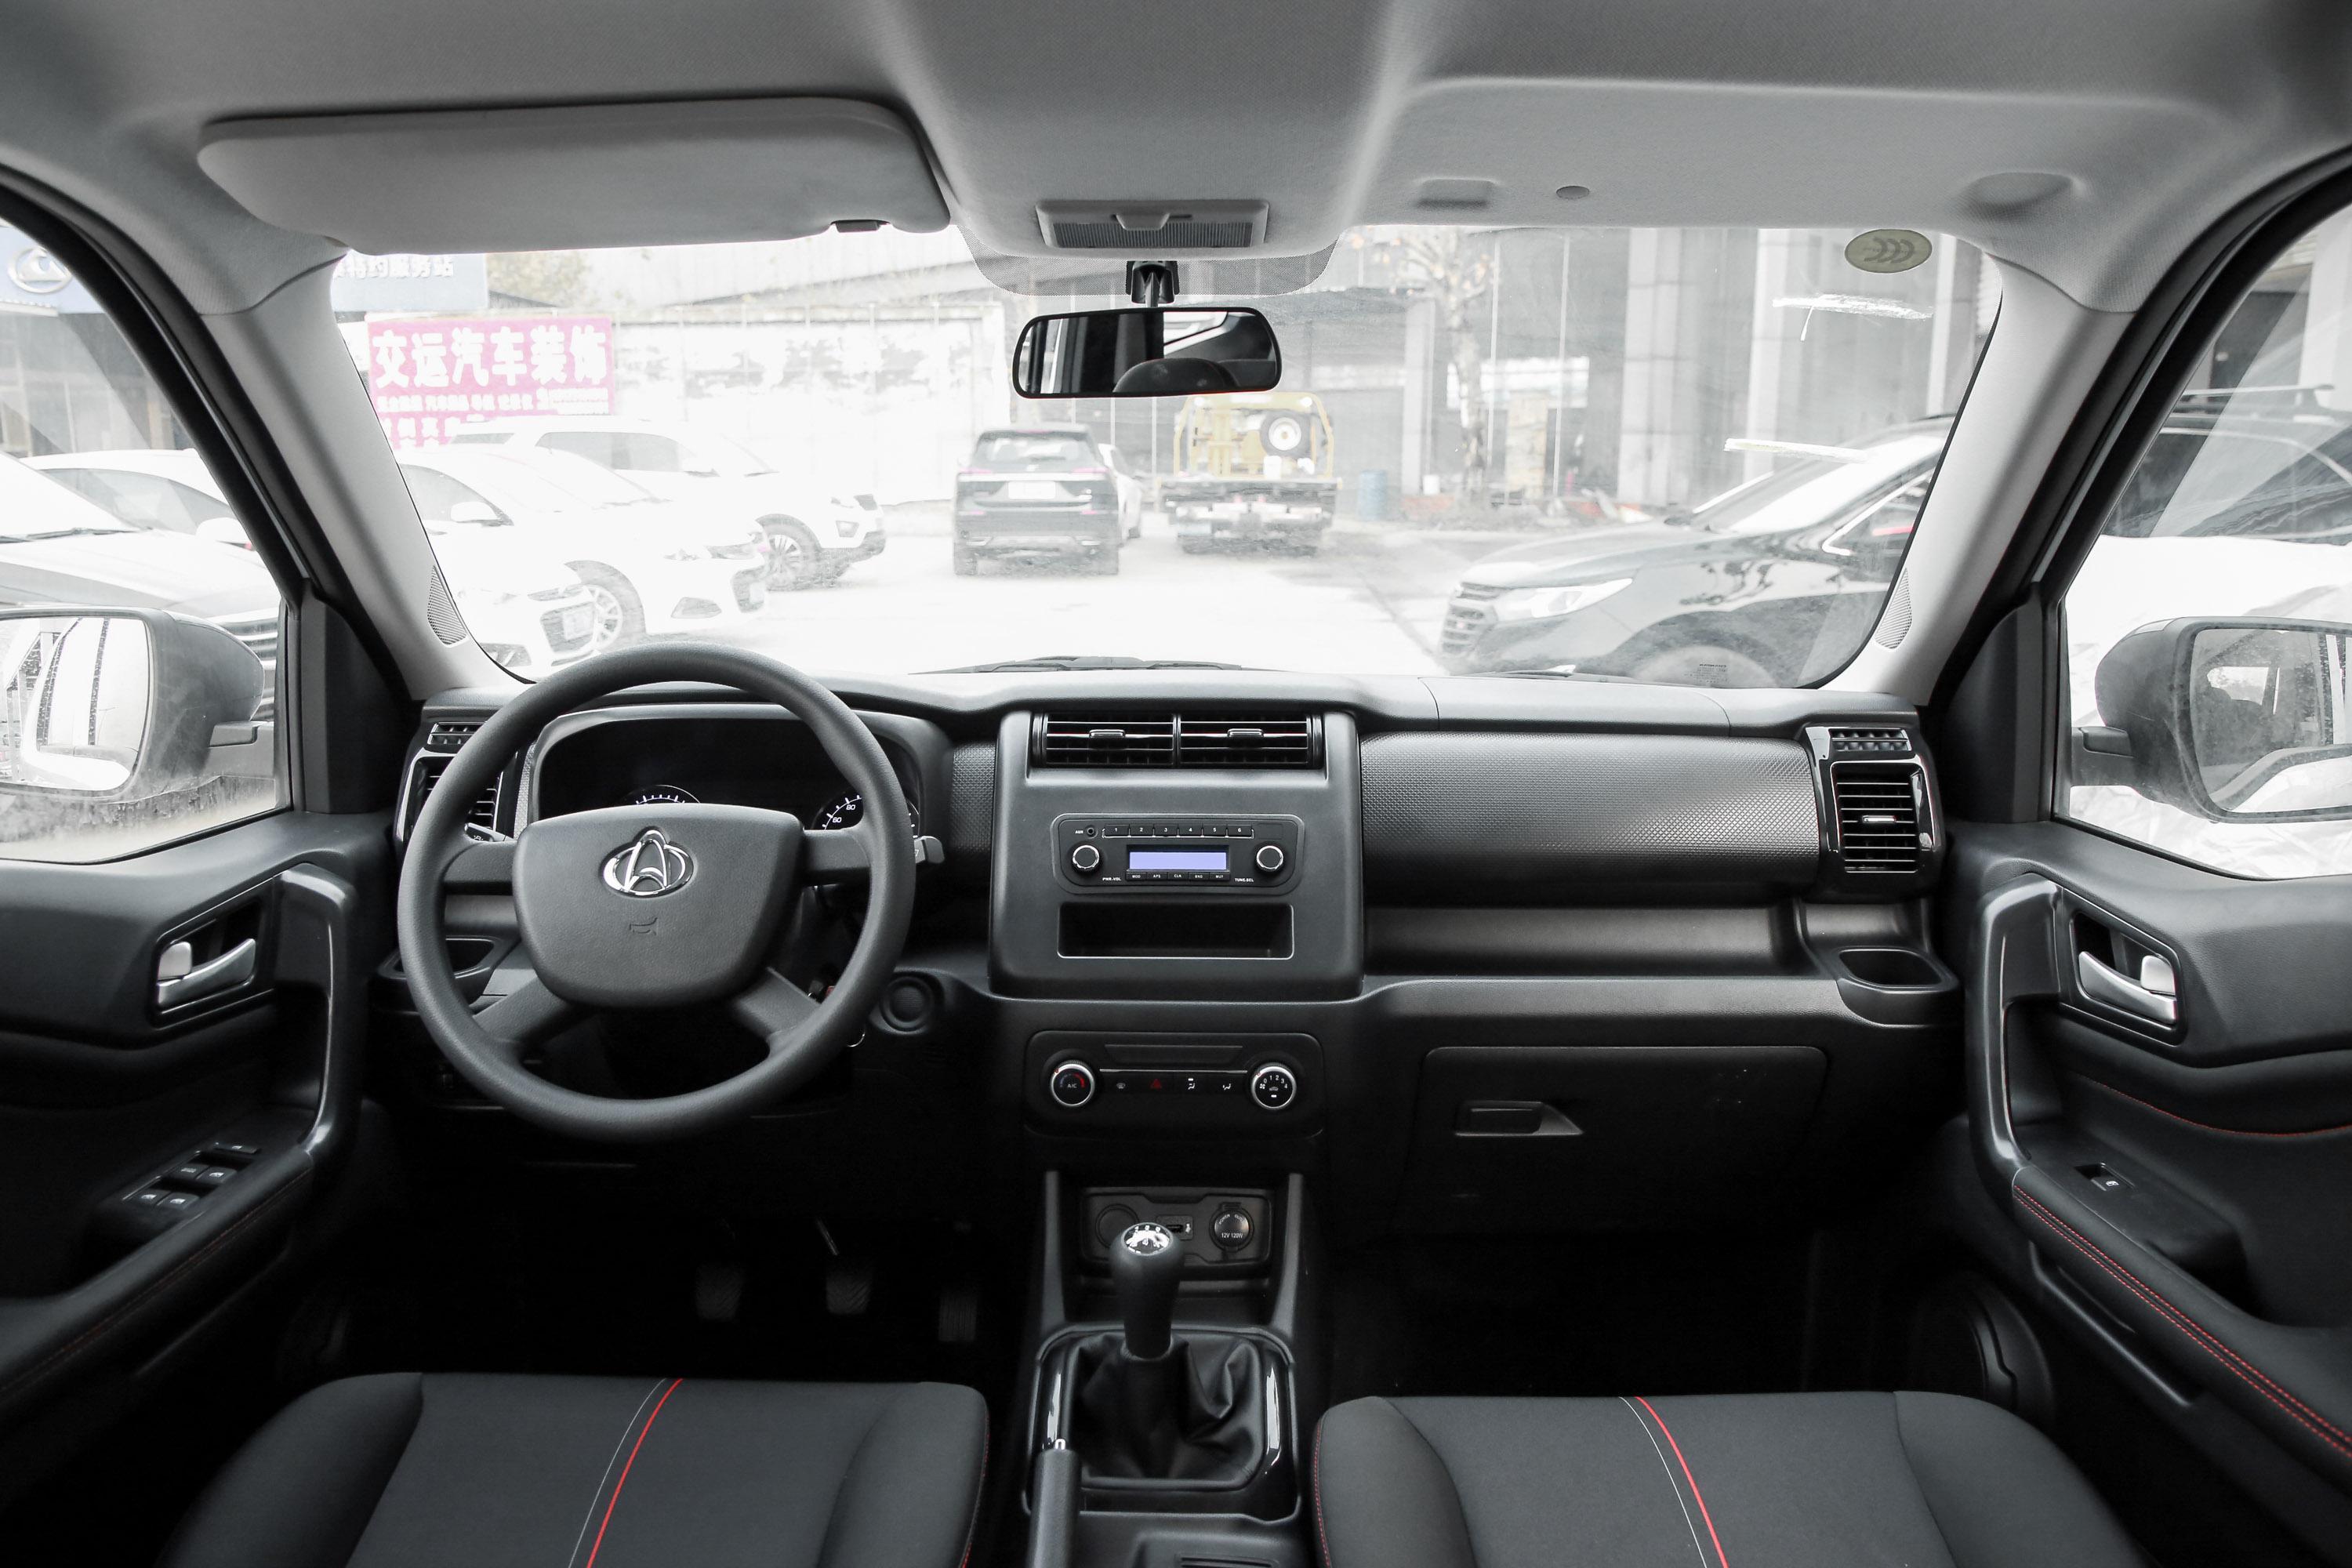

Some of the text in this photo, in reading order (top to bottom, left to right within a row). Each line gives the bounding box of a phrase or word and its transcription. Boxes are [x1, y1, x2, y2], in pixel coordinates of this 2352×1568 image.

[372, 325, 608, 389] 交运汽车装饰
